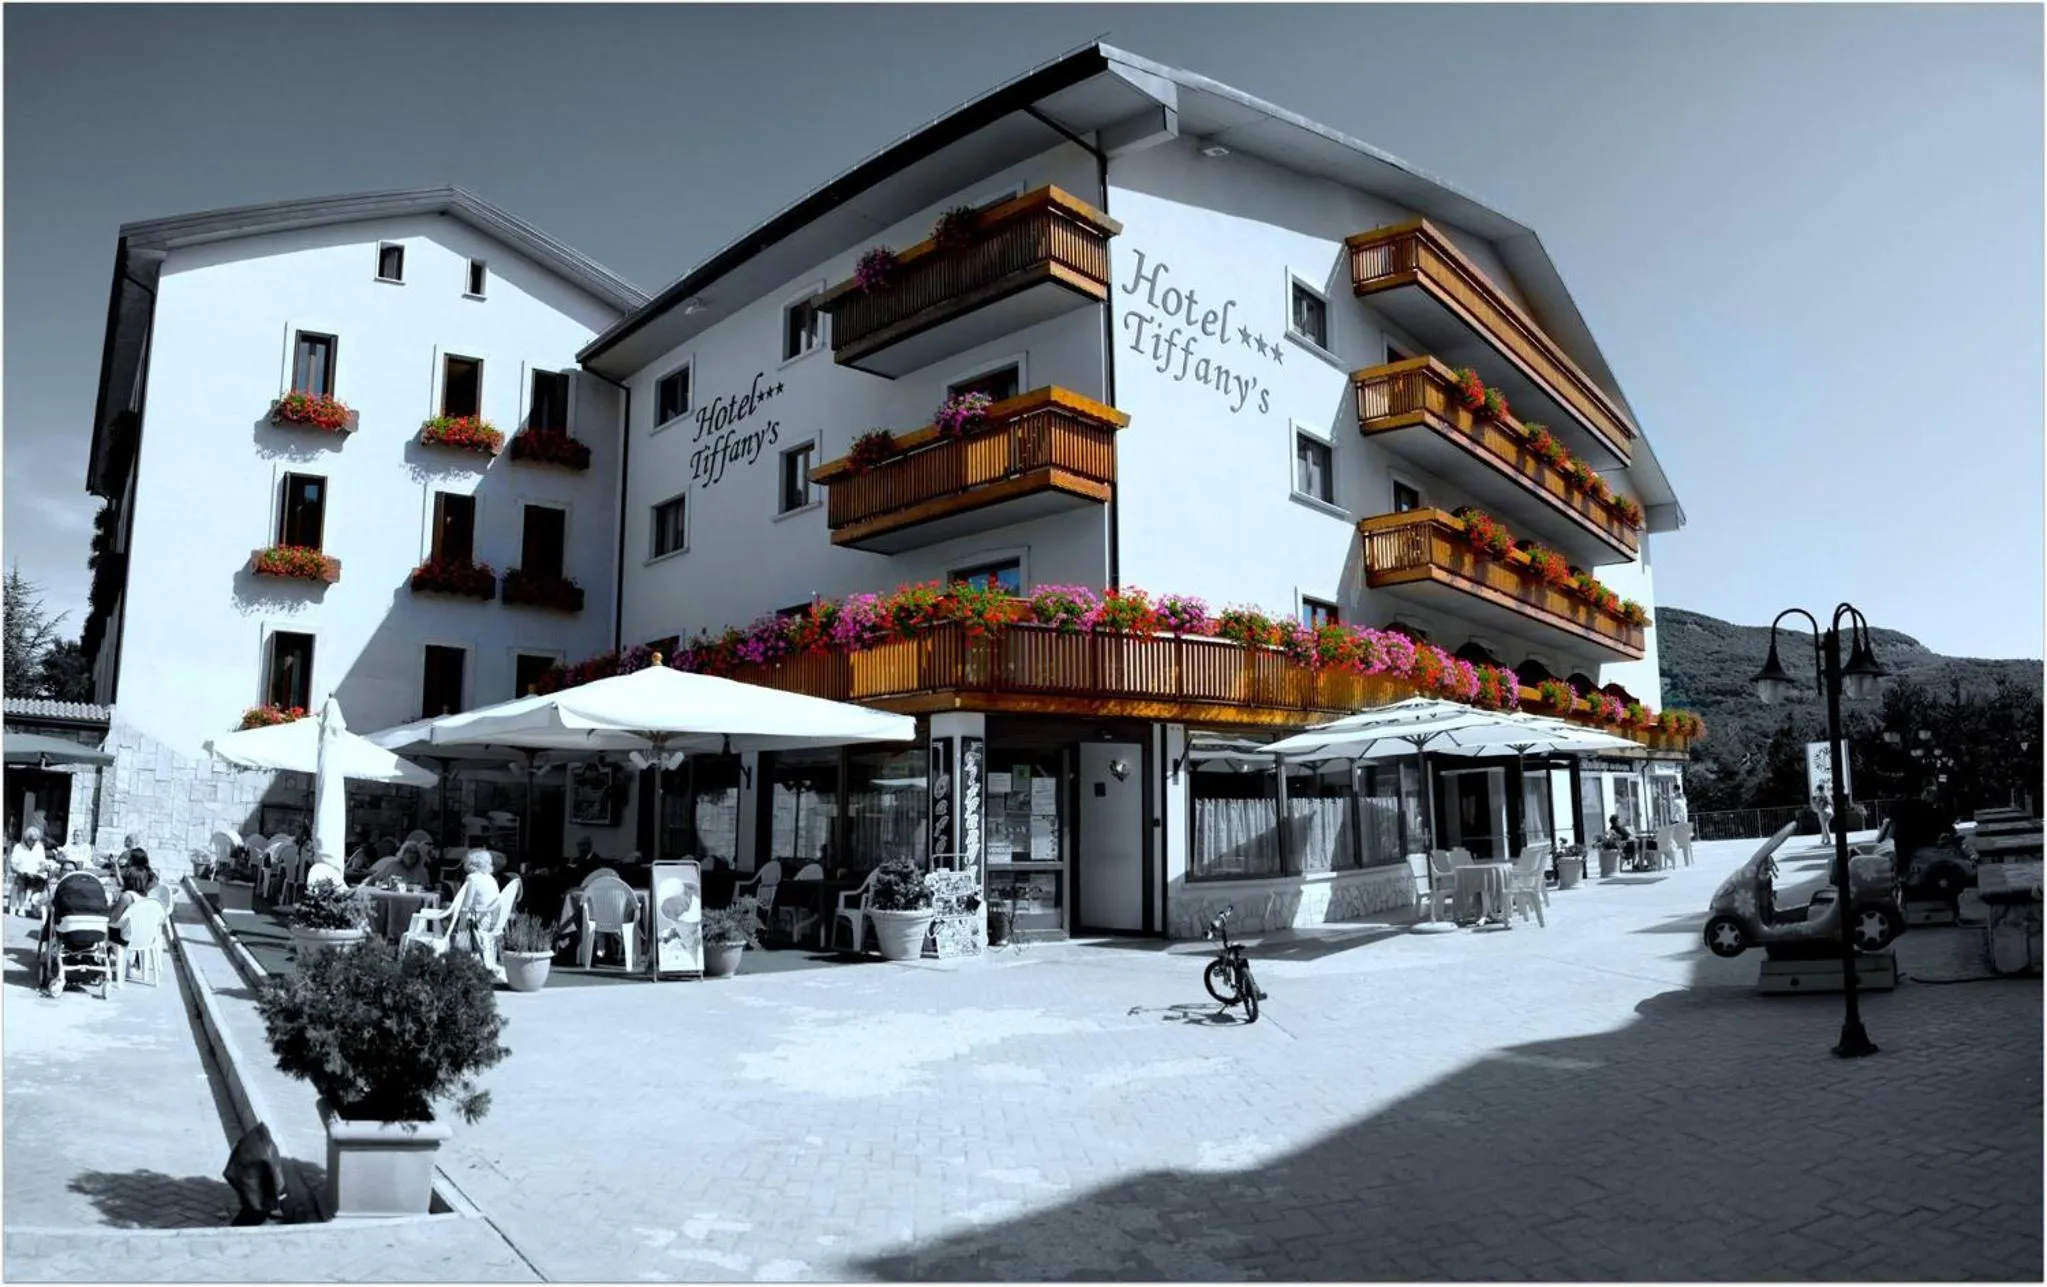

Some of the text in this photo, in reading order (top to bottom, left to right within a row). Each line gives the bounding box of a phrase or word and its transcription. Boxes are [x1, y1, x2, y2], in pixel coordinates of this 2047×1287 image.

[1121, 248, 1237, 345] Hotel
[1123, 310, 1270, 415] Tiffany's
[692, 371, 764, 443] Hotel
[689, 419, 780, 488] Tiffany's
